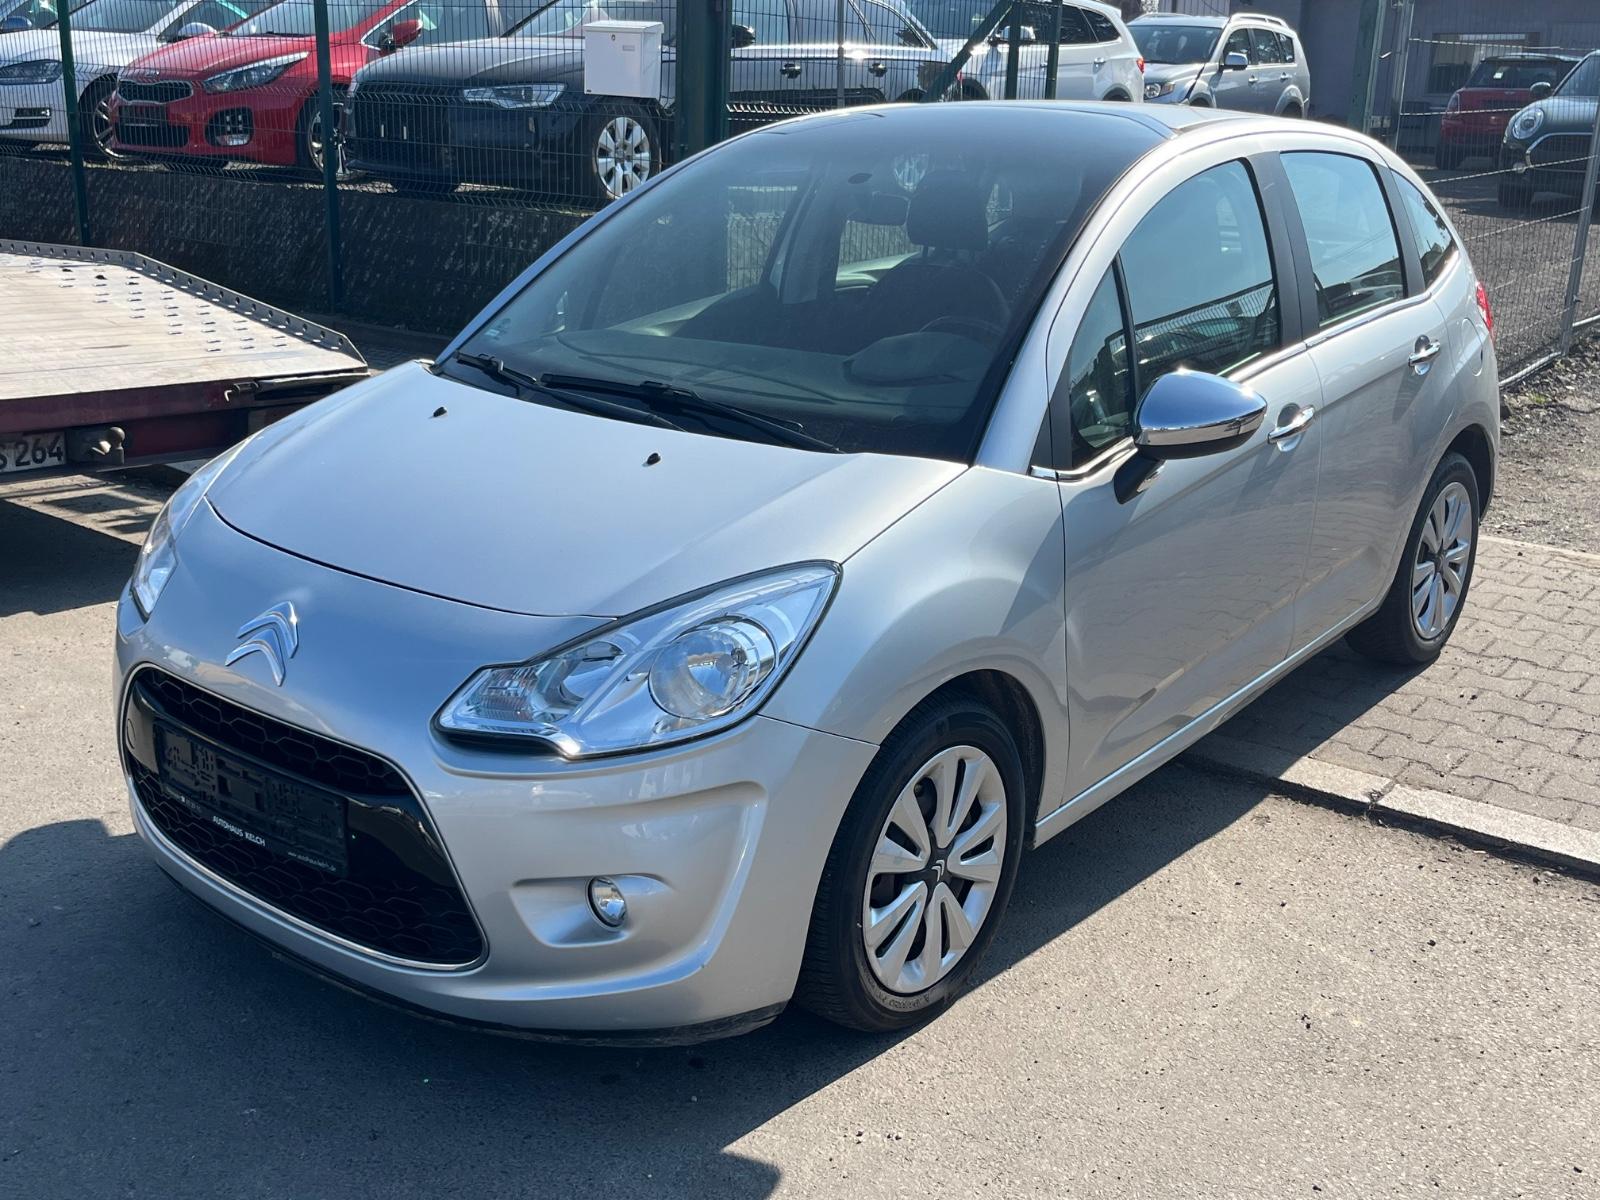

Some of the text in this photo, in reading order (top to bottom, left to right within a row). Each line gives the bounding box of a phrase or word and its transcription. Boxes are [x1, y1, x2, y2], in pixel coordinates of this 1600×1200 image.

[14, 435, 64, 467] 264
[212, 815, 266, 847] AUTOHAUS KELCH
